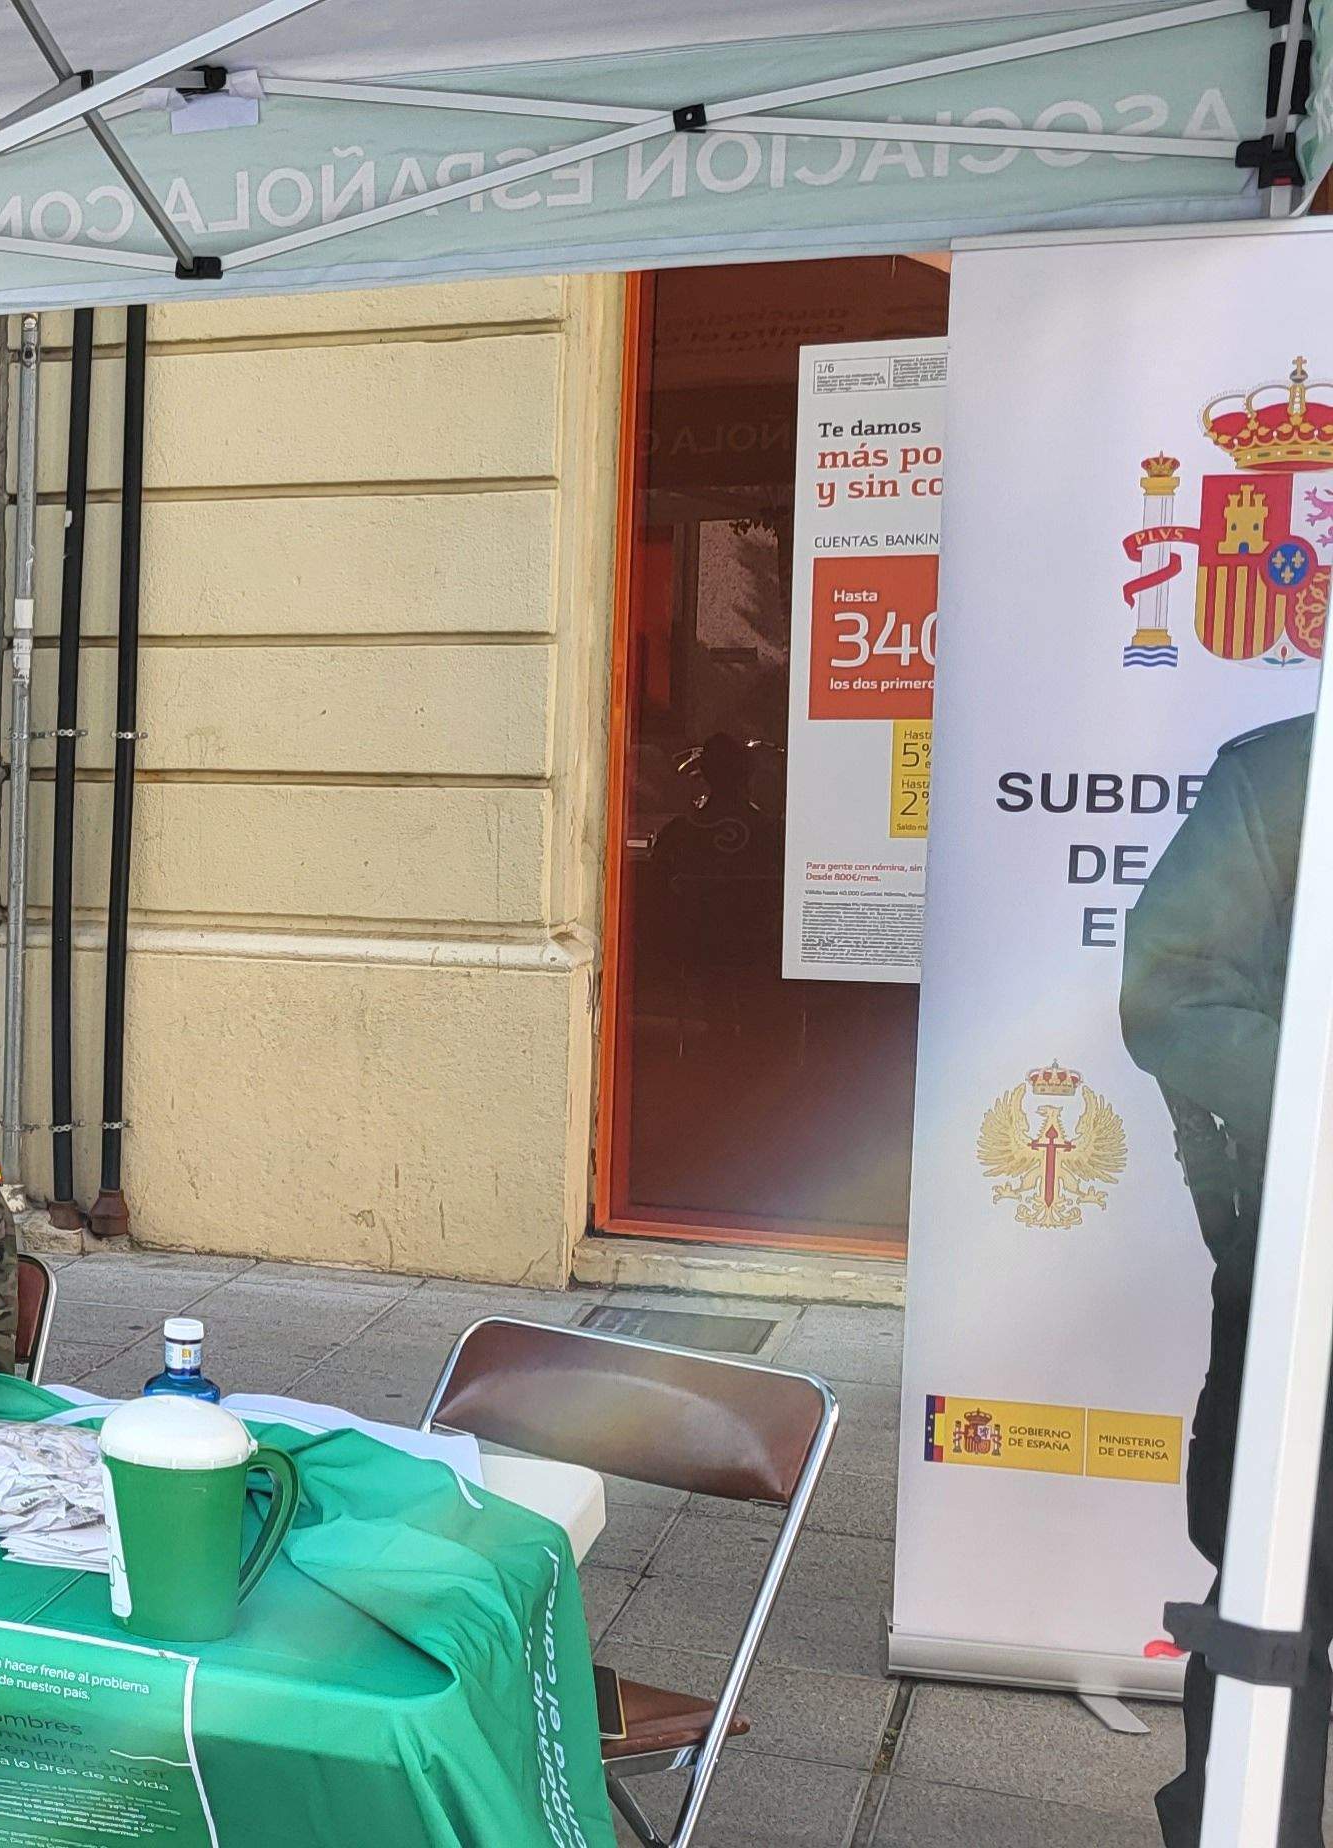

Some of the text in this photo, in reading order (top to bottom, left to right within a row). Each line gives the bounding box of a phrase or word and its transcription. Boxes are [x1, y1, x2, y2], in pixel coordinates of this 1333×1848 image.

[817, 363, 834, 374] 1/6
[818, 419, 922, 438] Te damos
[817, 442, 942, 474] más po
[816, 481, 836, 508] y
[848, 474, 900, 499] sin
[814, 533, 939, 549] CUENTAS BANKIN
[833, 589, 878, 603] Hasta
[830, 678, 850, 690] los
[853, 677, 878, 690] dos
[1008, 1425, 1071, 1440] GOBIERNO
[1008, 1437, 1070, 1452] DE ESPAÑA
[1099, 1434, 1165, 1448] MINISTERIO
[1099, 1447, 1169, 1461] DE DEFENSA
[4, 1657, 39, 1675] hacer
[40, 1664, 76, 1682] frente
[77, 1671, 90, 1685] al
[91, 1675, 150, 1695] problema
[16, 1679, 61, 1695] nuestro
[0, 1757, 10, 1766] a
[13, 1757, 30, 1768] lo
[33, 1760, 78, 1776] largo
[82, 1767, 104, 1780] de
[109, 1774, 129, 1785] su
